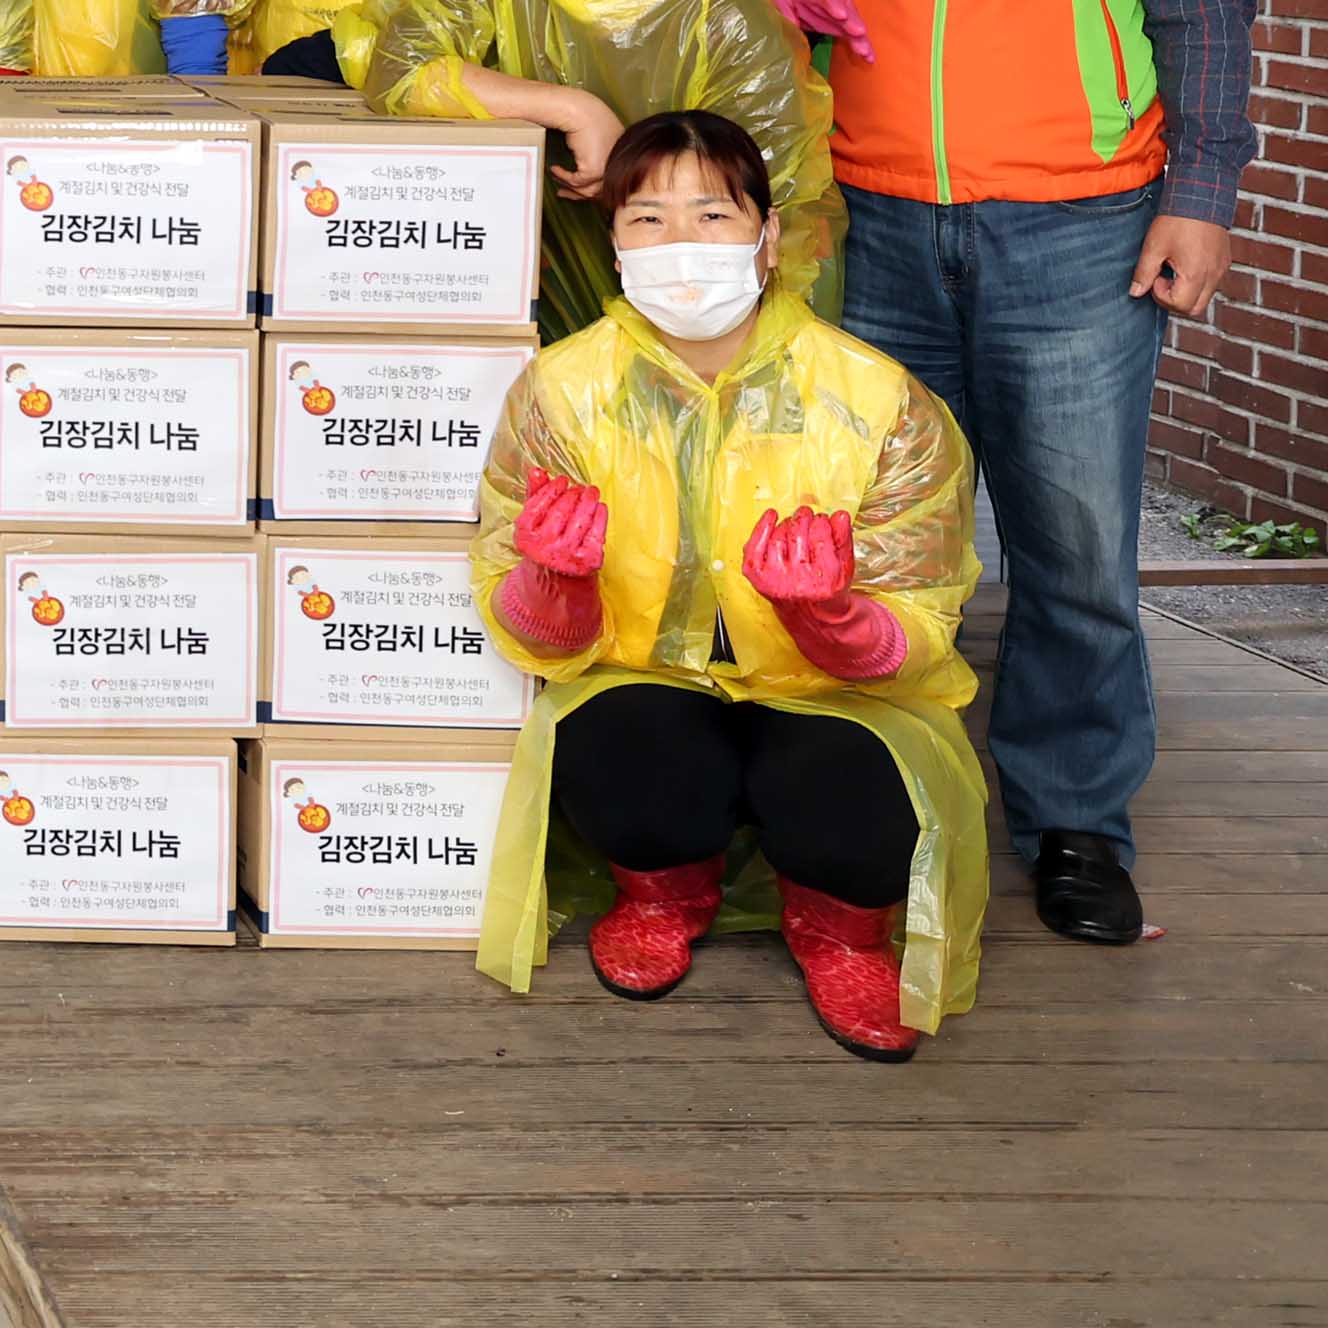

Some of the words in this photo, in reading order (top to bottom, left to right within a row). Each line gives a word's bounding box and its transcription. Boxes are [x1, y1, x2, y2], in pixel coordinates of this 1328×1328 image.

[41, 214, 141, 245] 김장김치
[151, 216, 201, 246] 나눔
[325, 219, 427, 249] 김장김치
[436, 220, 487, 250] 나눔
[57, 387, 107, 403] 계절김치
[108, 388, 121, 402] 및
[123, 387, 161, 403] 건강식
[162, 388, 188, 404] 전달
[39, 420, 139, 450] 김장김치
[150, 422, 200, 451] 나눔
[52, 627, 151, 656] 김장김치
[160, 627, 210, 655] 나눔
[361, 781, 436, 797] <나눔&동행>
[335, 801, 384, 817] 계절김치
[386, 803, 399, 817] 및
[401, 802, 439, 818] 건강식
[440, 803, 465, 819] 전달
[23, 828, 122, 858] 김장김치
[132, 829, 181, 859] 나눔
[318, 835, 418, 865] 김장김치
[428, 836, 478, 866] 나눔
[323, 887, 345, 900] 주관
[323, 904, 345, 917] 협력
